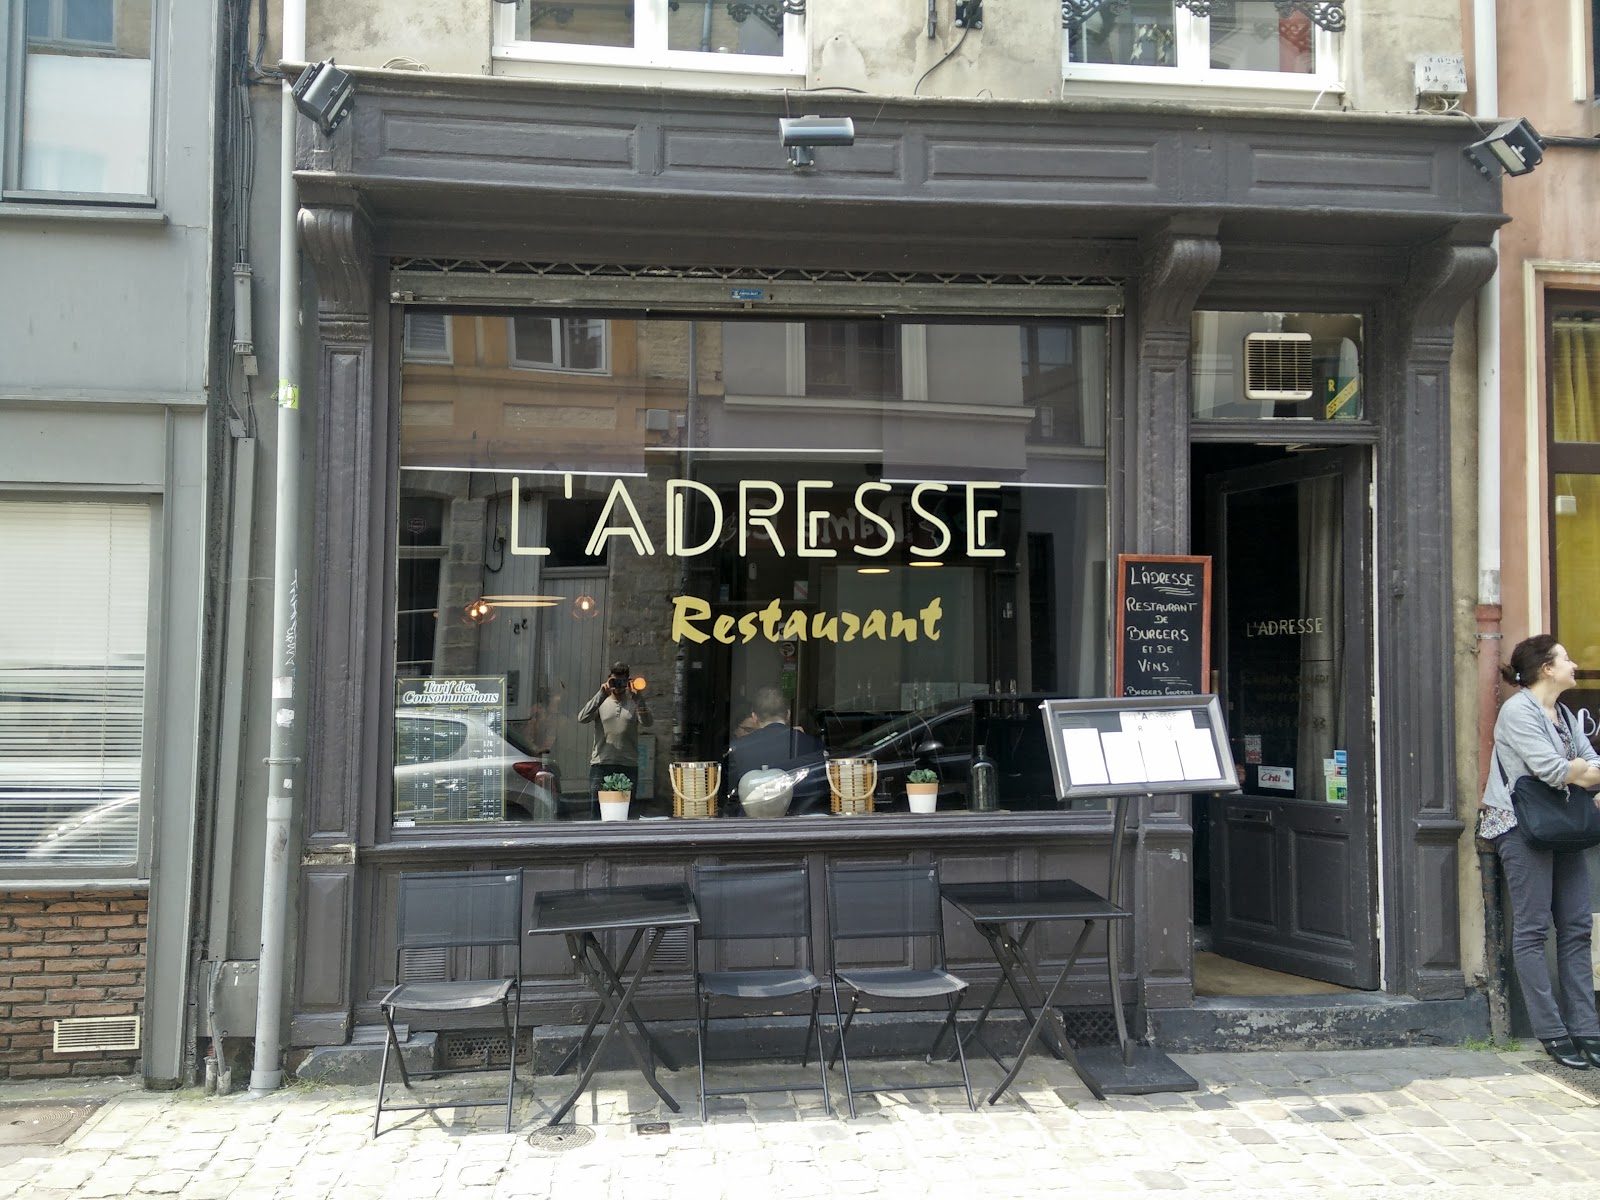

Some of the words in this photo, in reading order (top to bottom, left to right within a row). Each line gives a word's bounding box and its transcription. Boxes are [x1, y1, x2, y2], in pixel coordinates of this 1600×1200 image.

[511, 474, 1006, 558] L'ADRESSE
[1131, 566, 1195, 587] L'ADRESSE
[1126, 597, 1197, 613] RESTAURANT
[671, 595, 943, 645] Restaurant
[1154, 614, 1169, 624] DE
[1126, 626, 1190, 642] BURGERS
[1246, 617, 1324, 638] L'ADRESSE
[1142, 645, 1154, 654] ET
[1156, 645, 1174, 654] DE
[423, 680, 455, 694] Tarif
[455, 680, 476, 693] des
[403, 691, 499, 704] Consommations
[1577, 708, 1600, 736] B
